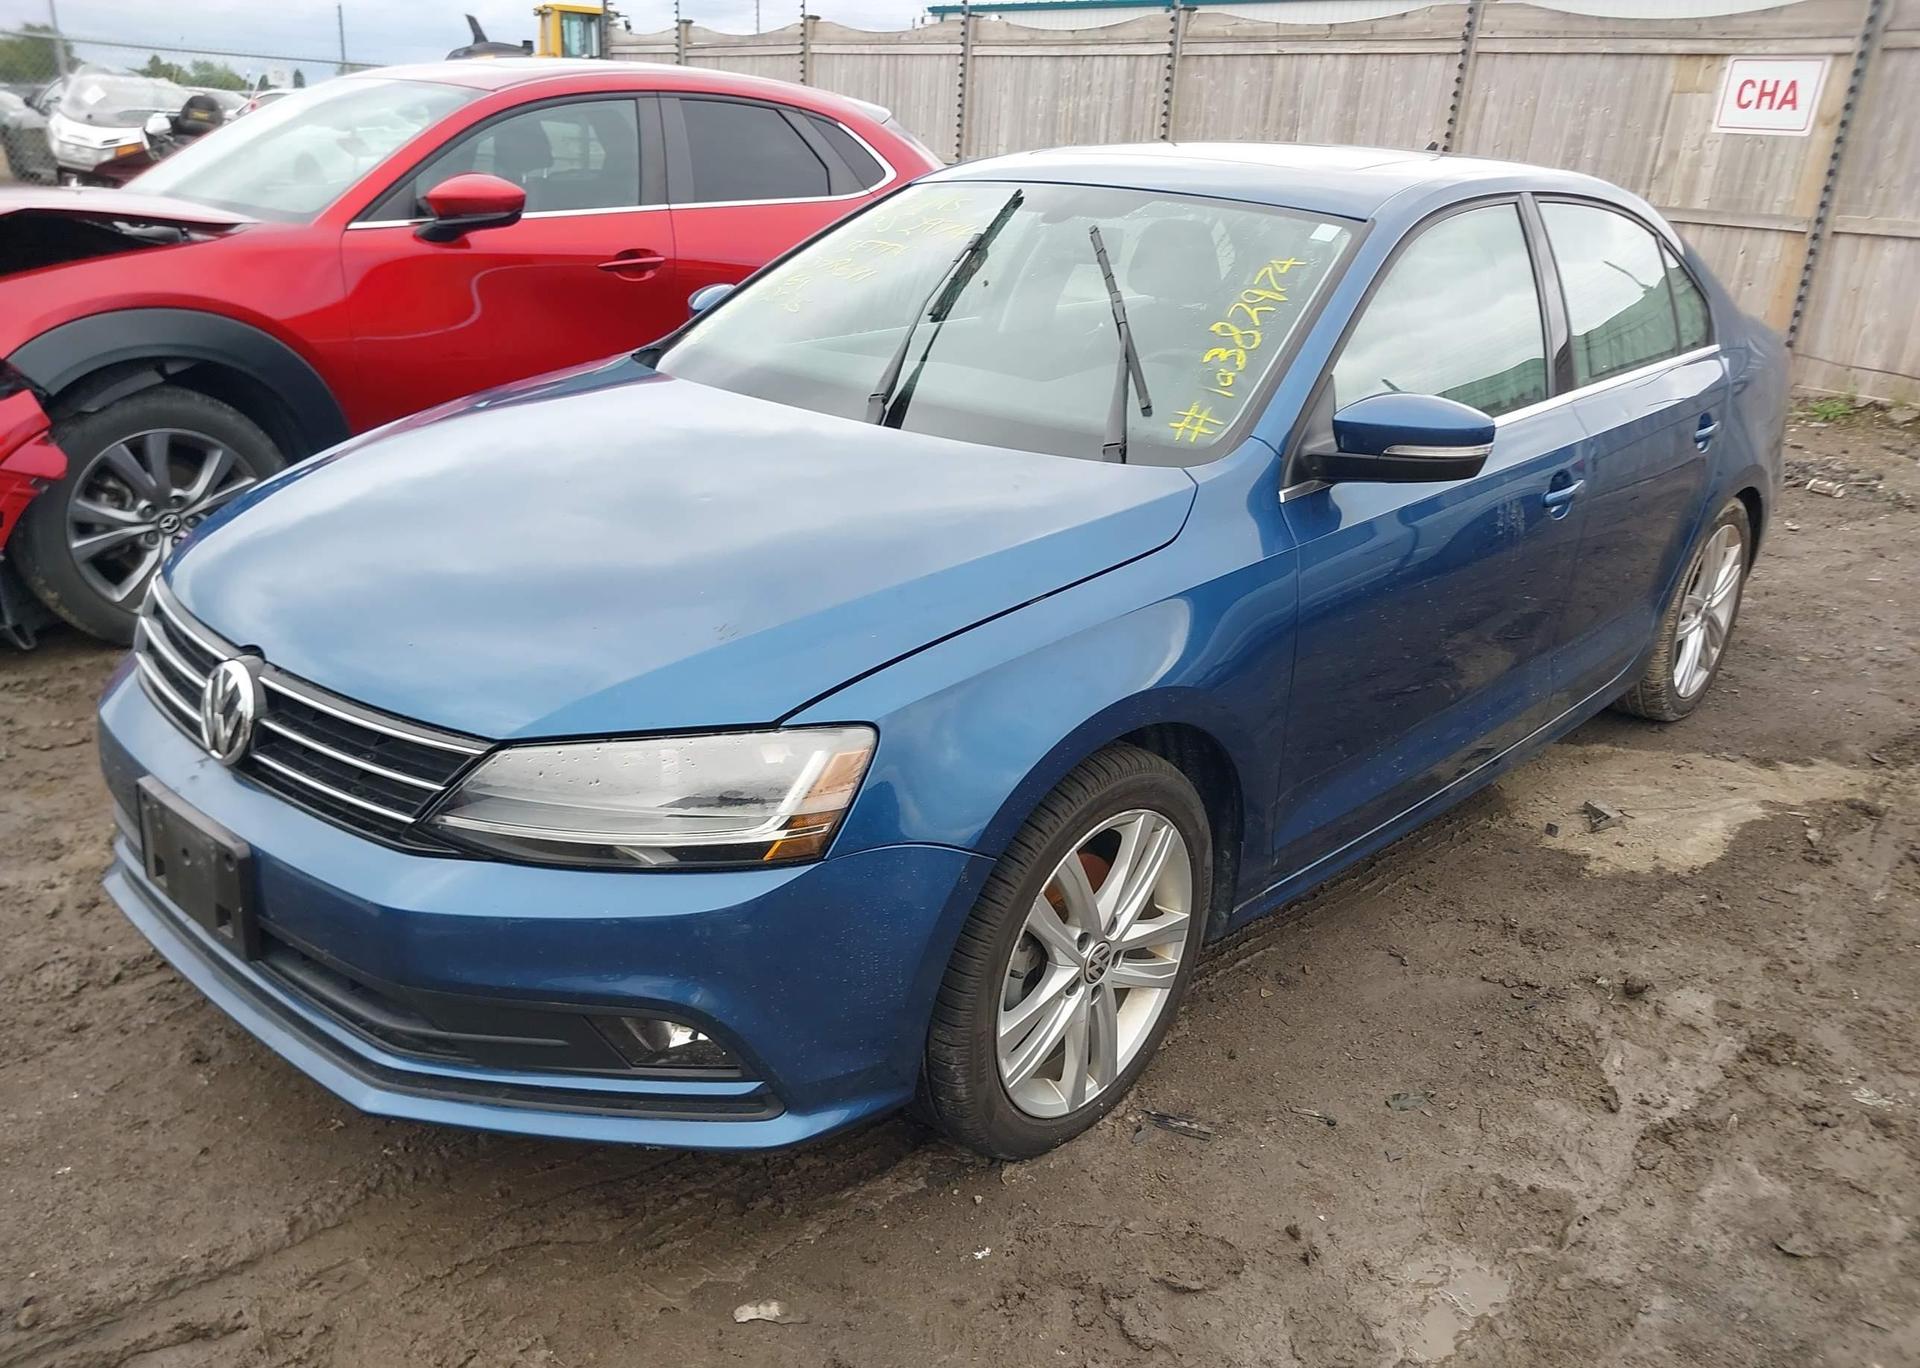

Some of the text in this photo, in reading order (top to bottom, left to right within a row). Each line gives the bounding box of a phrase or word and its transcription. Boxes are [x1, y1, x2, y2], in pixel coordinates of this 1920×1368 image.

[1736, 79, 1798, 111] CHA
[1168, 401, 1225, 443] #
[202, 659, 254, 765] VW
[1085, 942, 1111, 983] VW
